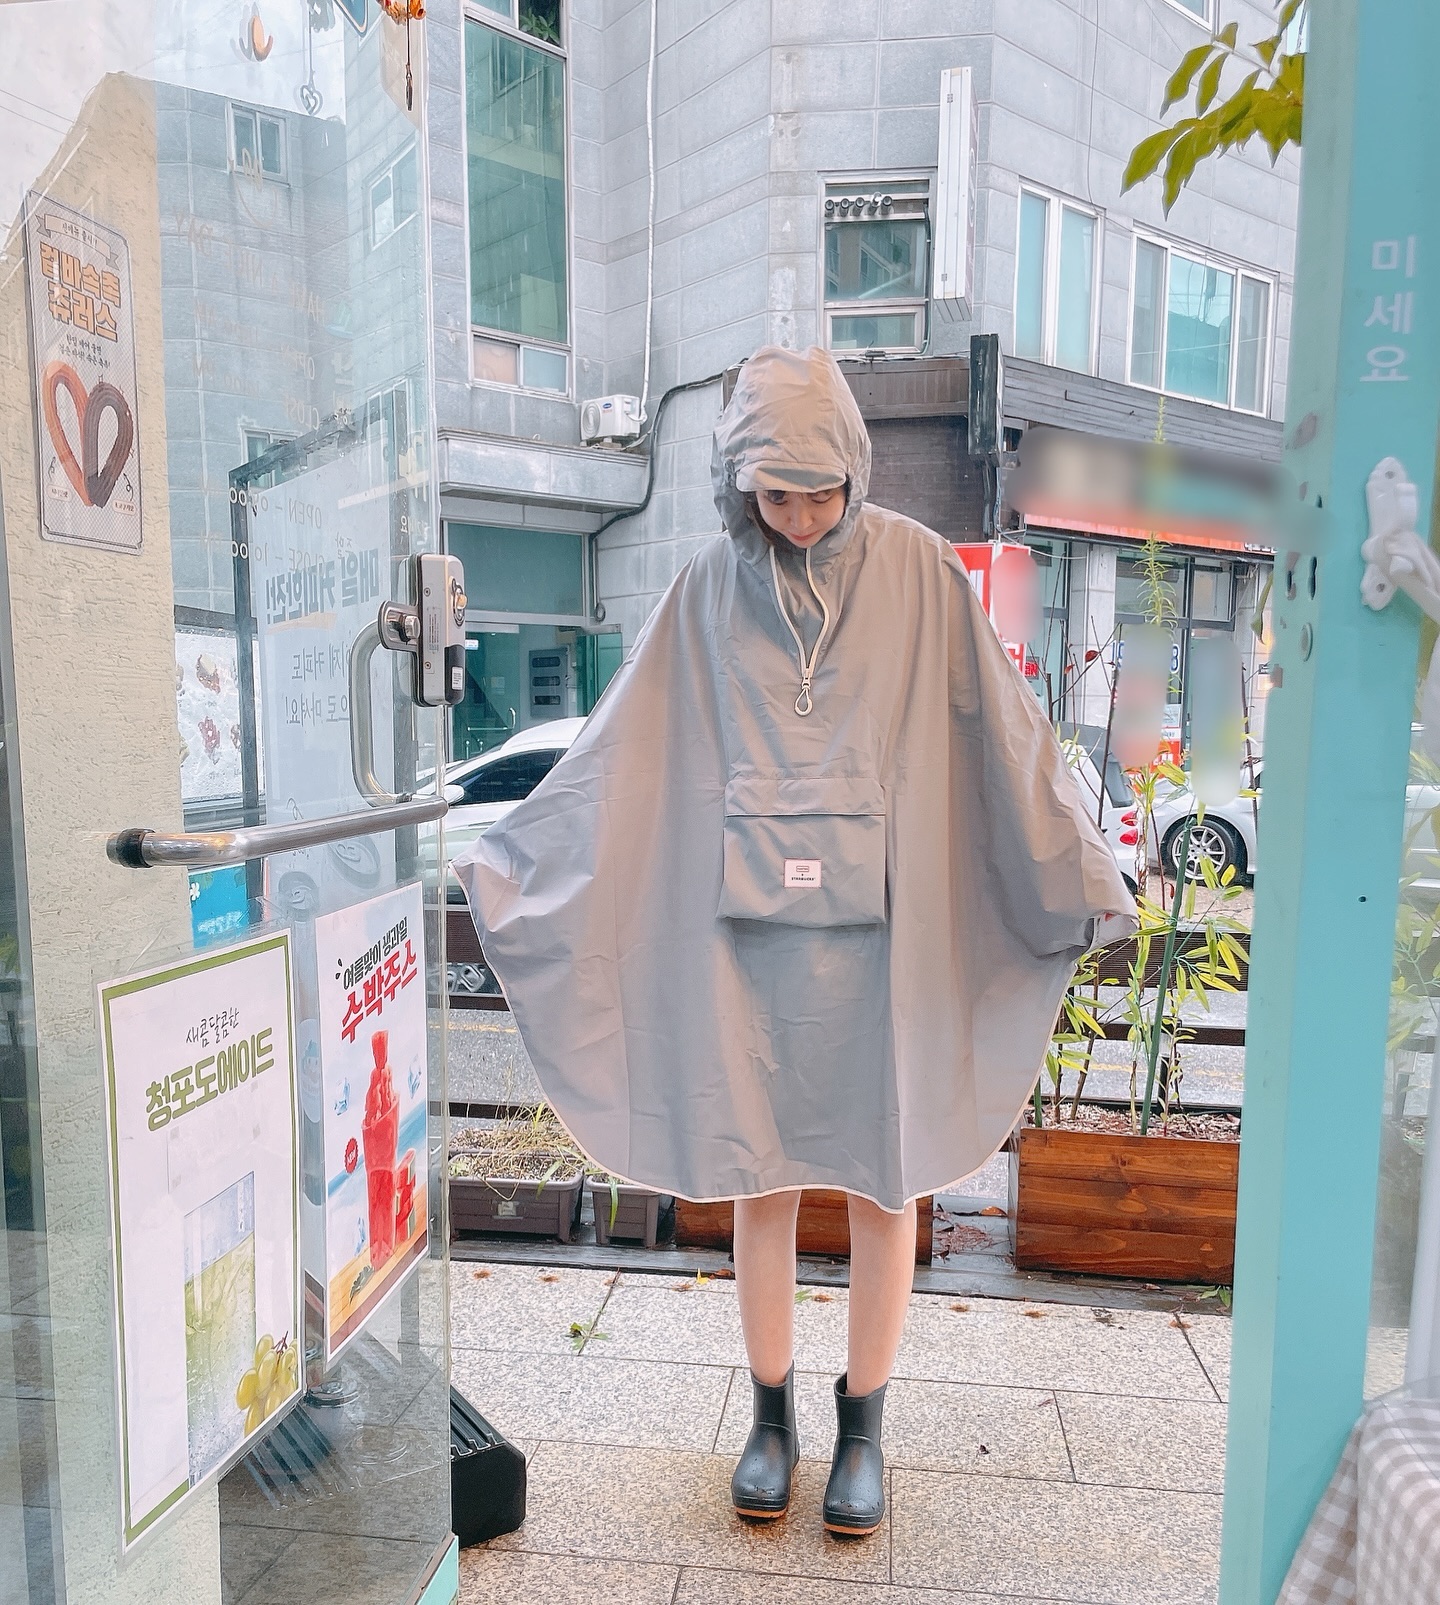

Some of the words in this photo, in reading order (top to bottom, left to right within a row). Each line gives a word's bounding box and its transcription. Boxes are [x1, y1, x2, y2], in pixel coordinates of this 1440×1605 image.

[39, 241, 122, 309] 겉바속촉
[1359, 235, 1416, 382] 미세요
[341, 938, 418, 1044] 수박주스
[343, 940, 382, 991] 여름맞이
[382, 915, 408, 957] 생과일
[186, 1006, 240, 1048] 새콤달콤한
[145, 1026, 275, 1132] 청포도에이드
